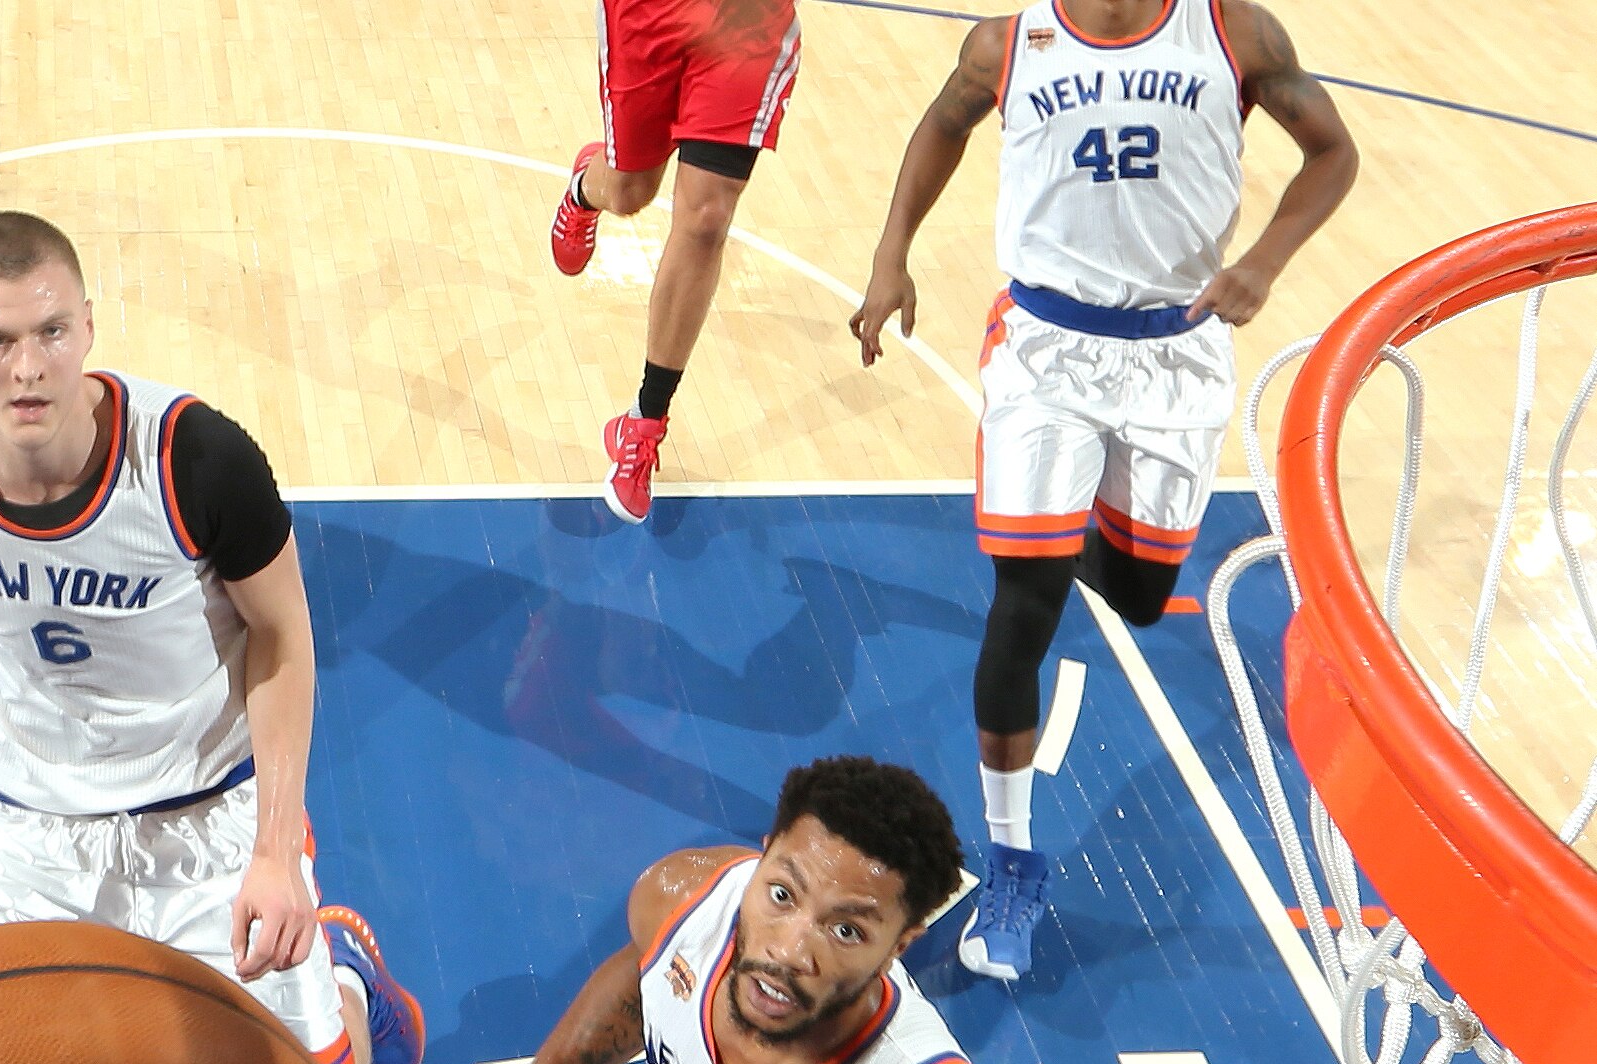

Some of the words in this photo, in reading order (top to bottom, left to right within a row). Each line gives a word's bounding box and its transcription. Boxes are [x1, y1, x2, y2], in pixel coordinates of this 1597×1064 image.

[1028, 70, 1104, 122] NEW
[1118, 69, 1209, 111] YORK
[1072, 124, 1162, 183] 42
[45, 564, 163, 609] YORK
[30, 620, 93, 665] 6
